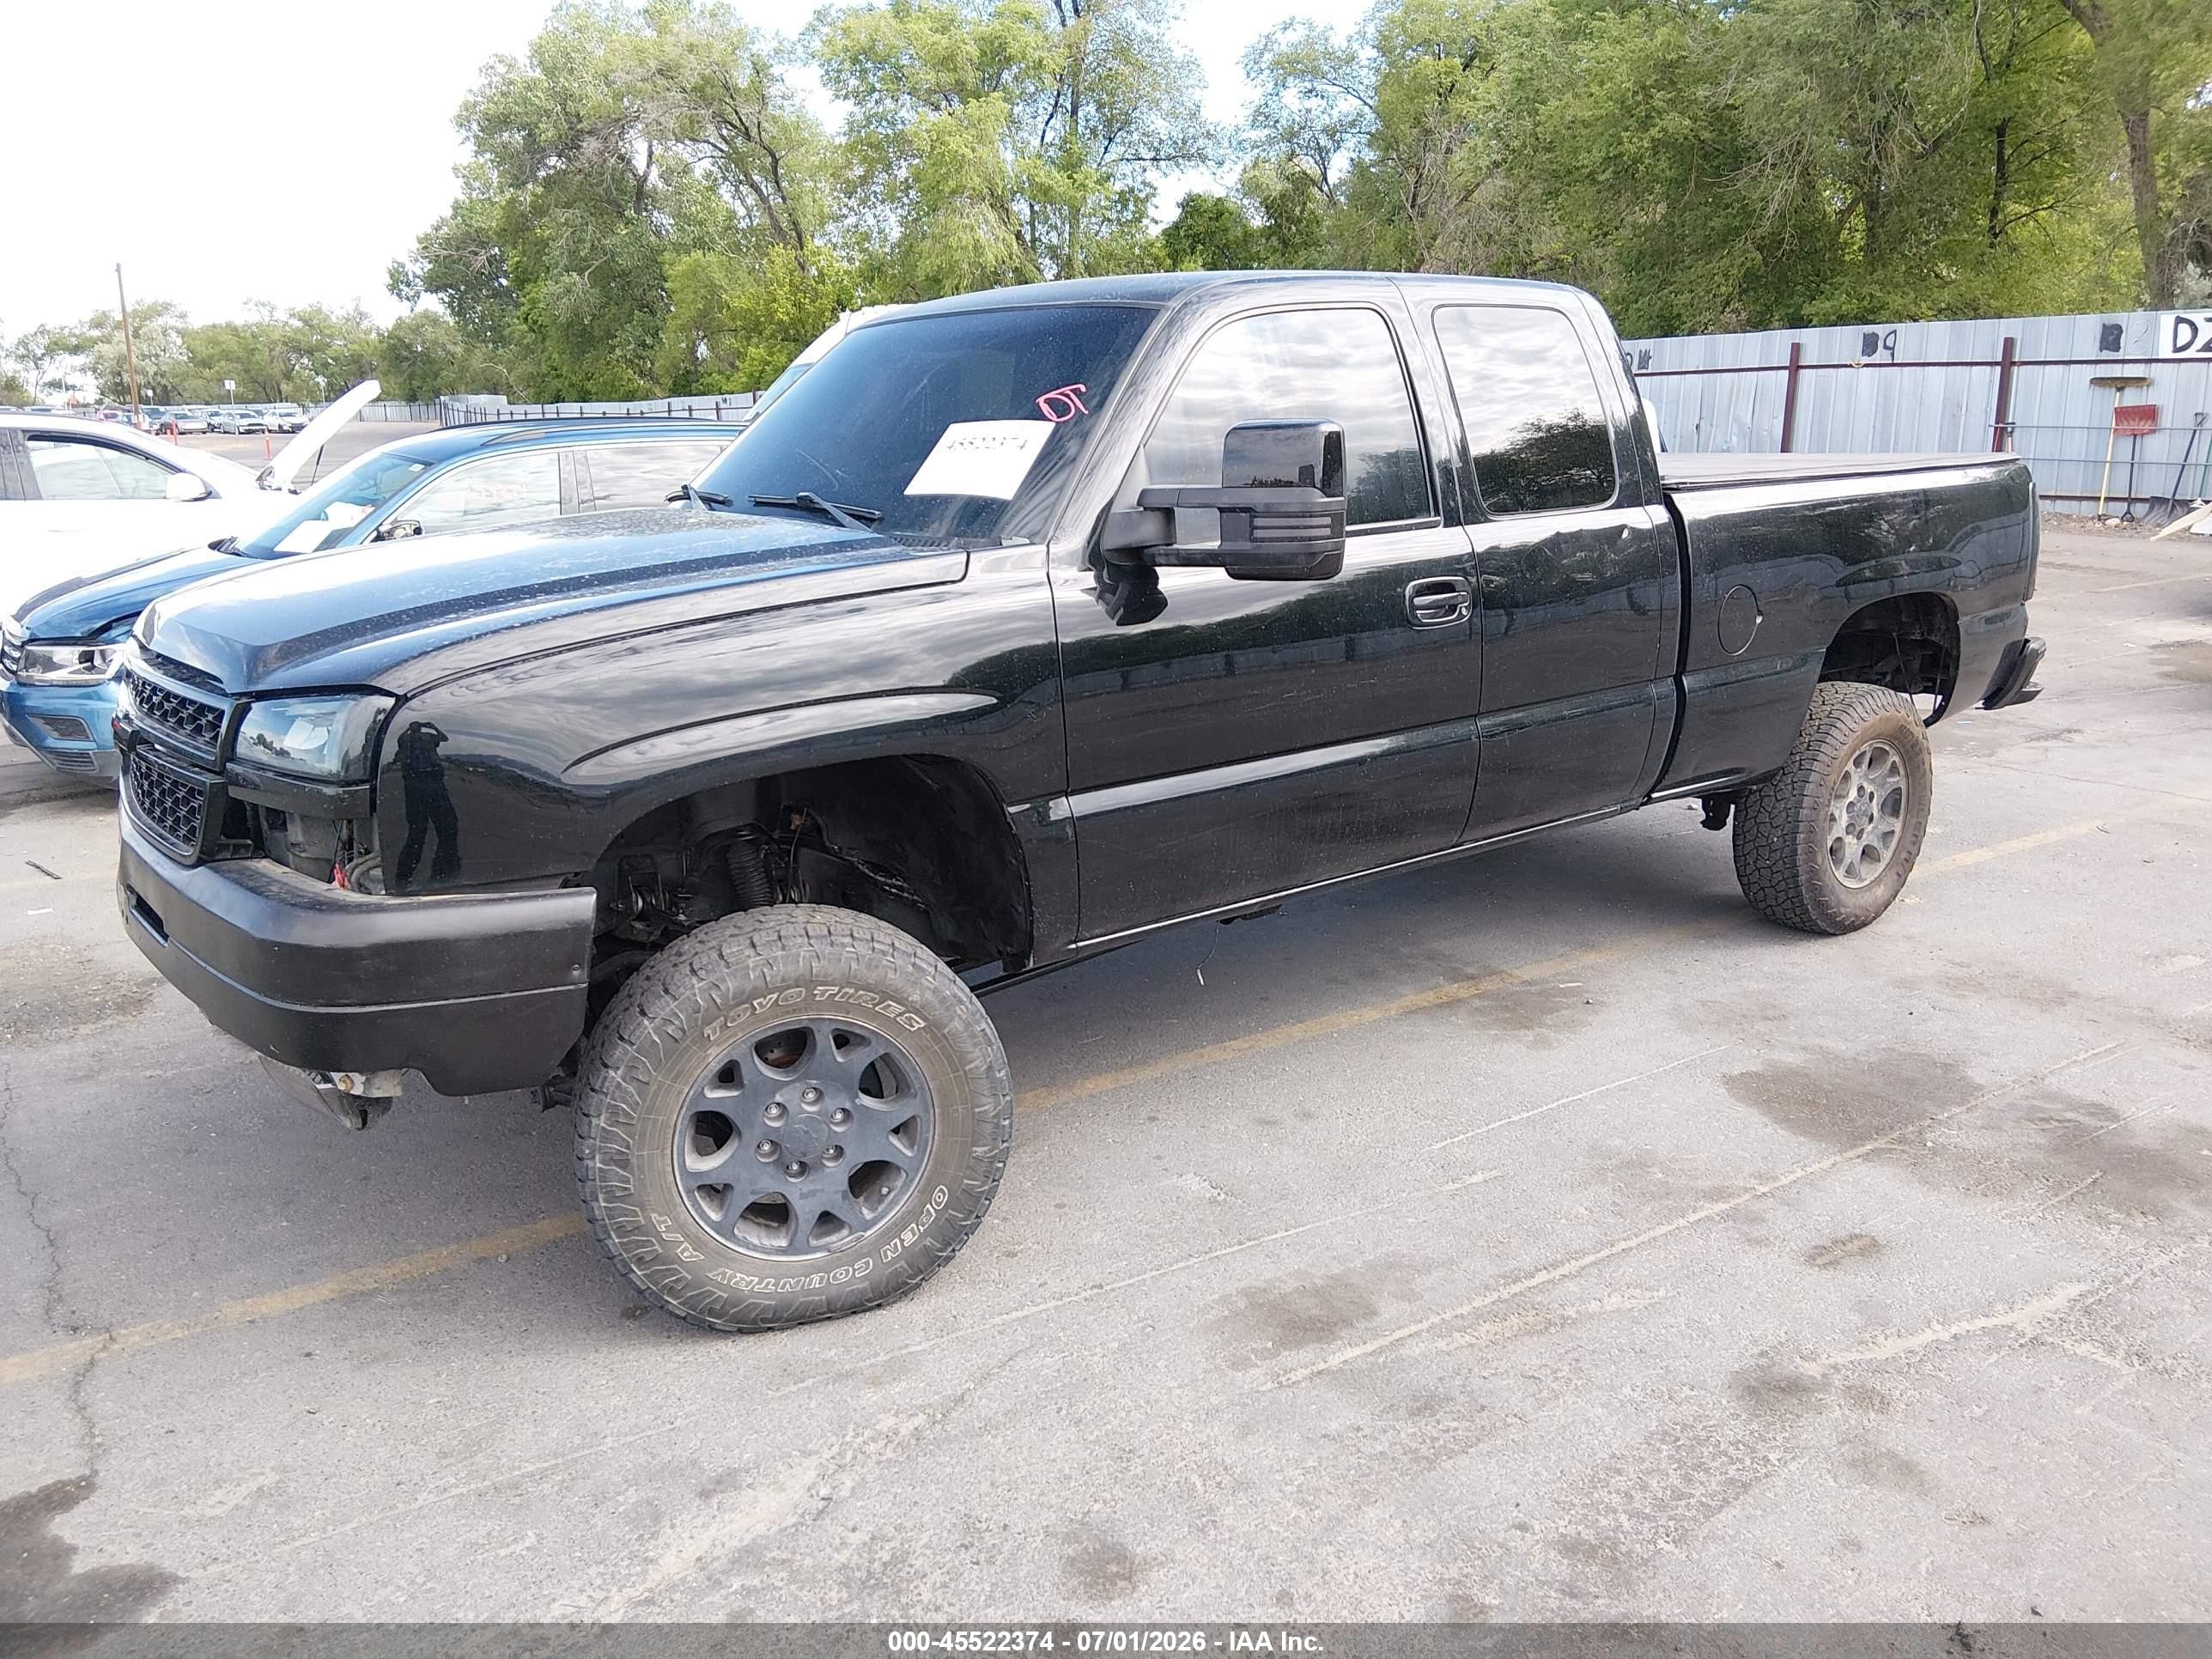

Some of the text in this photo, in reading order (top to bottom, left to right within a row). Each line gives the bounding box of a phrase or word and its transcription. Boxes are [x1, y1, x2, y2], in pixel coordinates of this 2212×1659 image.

[704, 986, 927, 1041] TOYO TIRES
[651, 1185, 949, 1293] OPEN COUNTRY A/T
